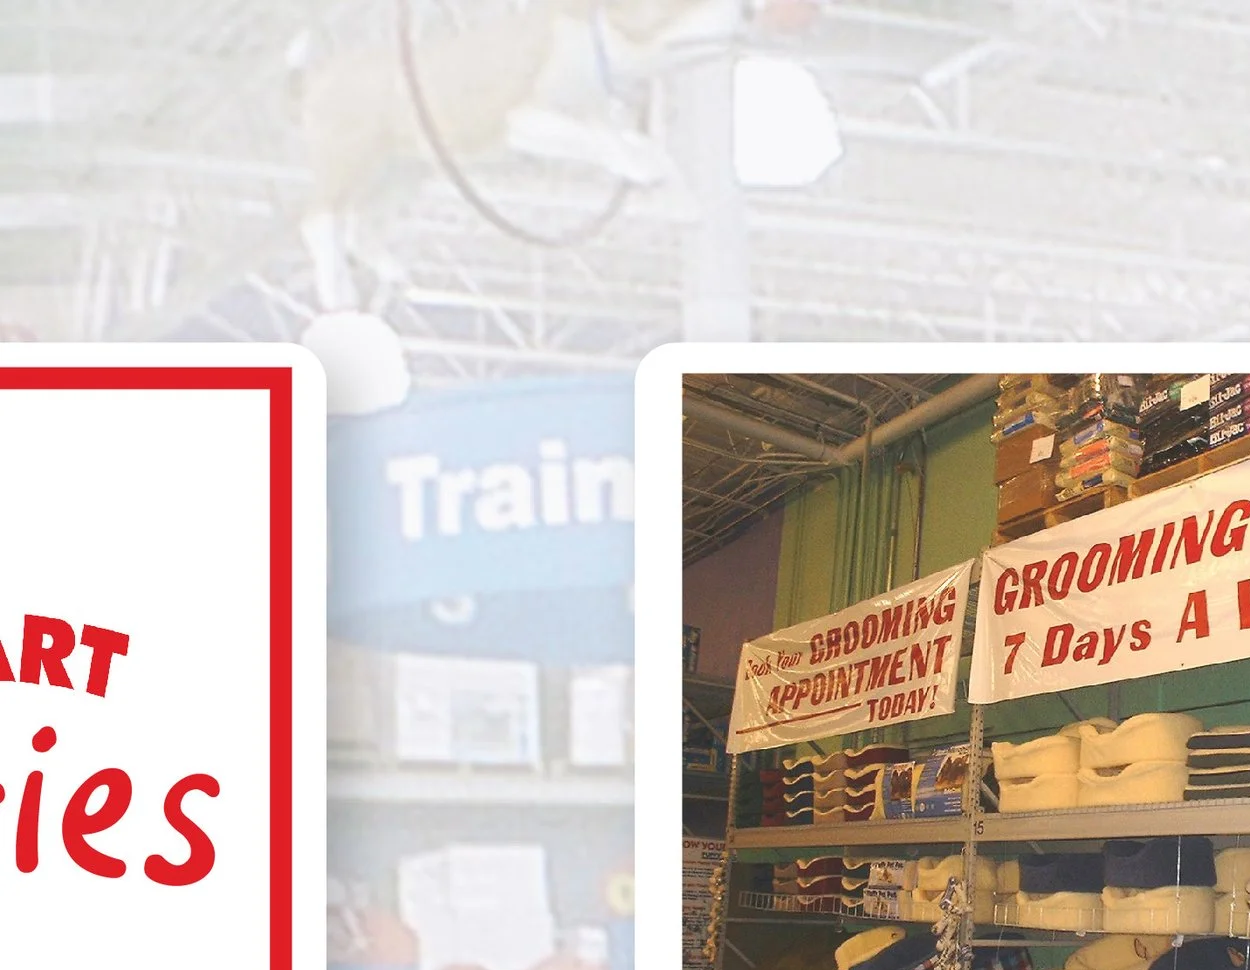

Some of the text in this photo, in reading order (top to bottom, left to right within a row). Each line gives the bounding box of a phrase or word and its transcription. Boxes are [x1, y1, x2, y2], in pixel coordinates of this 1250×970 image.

[386, 438, 635, 543] Train
[809, 586, 957, 665] GROOMING
[1004, 632, 1026, 675] 7
[1041, 619, 1151, 666] Days
[1176, 590, 1210, 643] A
[766, 634, 953, 716] APPOINTMENT
[867, 684, 939, 722] TODAY!
[0, 727, 220, 886] ies
[973, 821, 985, 836] 15
